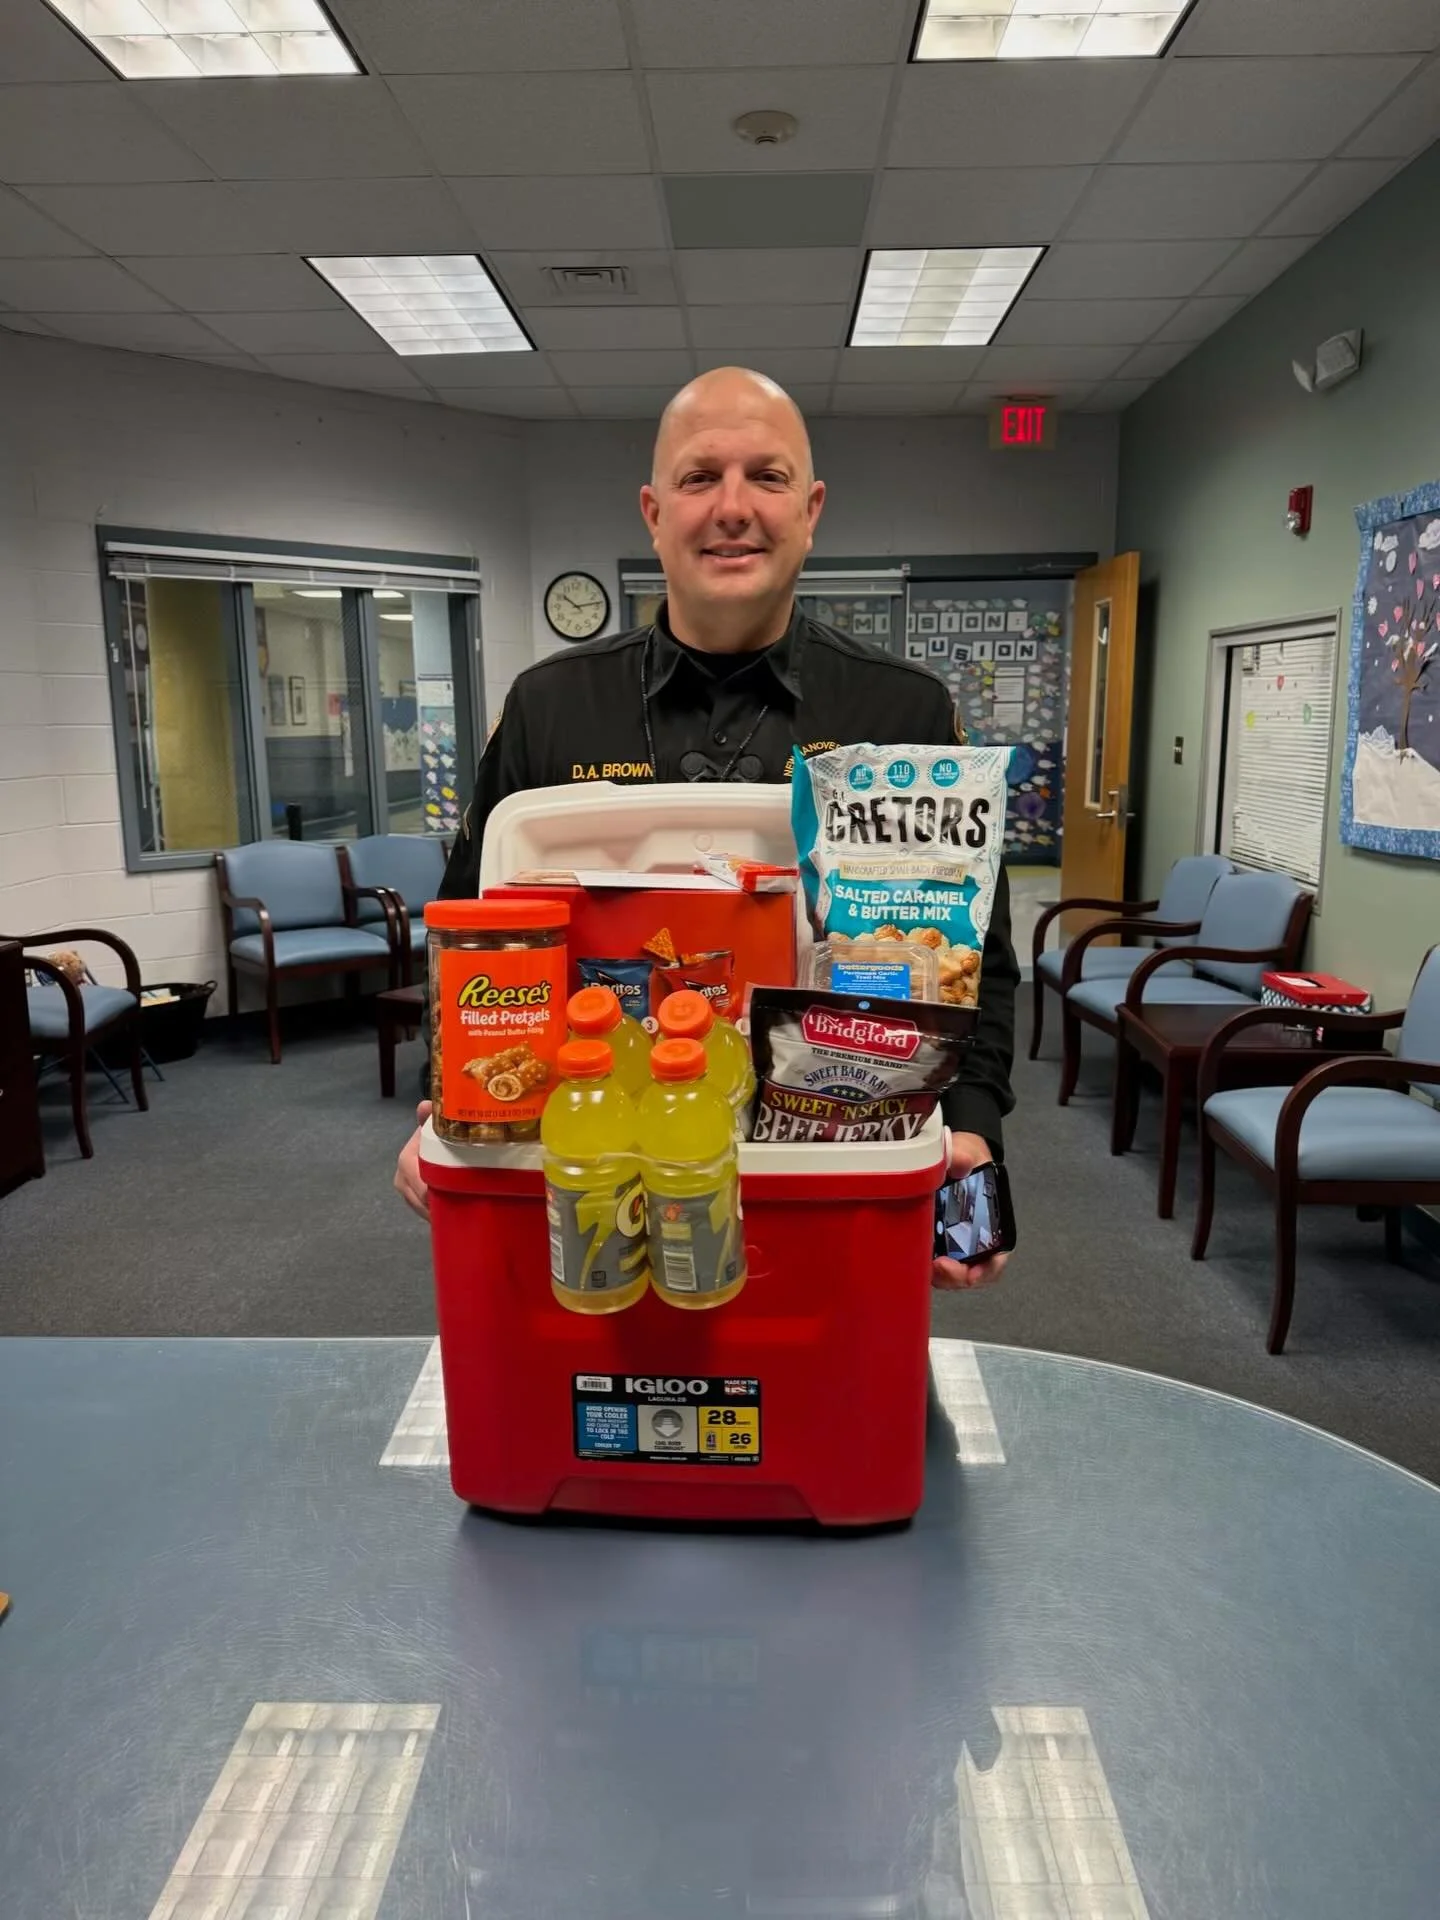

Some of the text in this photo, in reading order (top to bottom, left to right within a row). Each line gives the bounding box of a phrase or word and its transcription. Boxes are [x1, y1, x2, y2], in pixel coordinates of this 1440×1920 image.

[1002, 407, 1046, 443] EXIT
[909, 640, 1034, 661] LUSION
[602, 762, 655, 778] BROWN
[893, 764, 910, 775] 110
[938, 763, 953, 772] NO
[825, 796, 990, 848] CRETORS
[835, 884, 968, 906] SALTED CARAMEL
[848, 903, 952, 921] & BUTTER MIX
[458, 974, 552, 1008] Reese's
[700, 984, 728, 998] ritos
[460, 1008, 550, 1027] Filled Pretzels
[645, 1020, 654, 1031] 3
[814, 1012, 908, 1049] Bridgford
[812, 1047, 828, 1056] THE
[830, 1050, 871, 1064] PREMIUM
[804, 1065, 838, 1087] SWEET
[840, 1065, 870, 1081] BABY
[770, 1091, 837, 1118] SWEET
[858, 1099, 908, 1118] SPICY
[752, 1101, 922, 1142] BEEF JERKY
[625, 1377, 709, 1395] IGLOO
[708, 1410, 736, 1425] 28
[730, 1433, 751, 1445] 26
